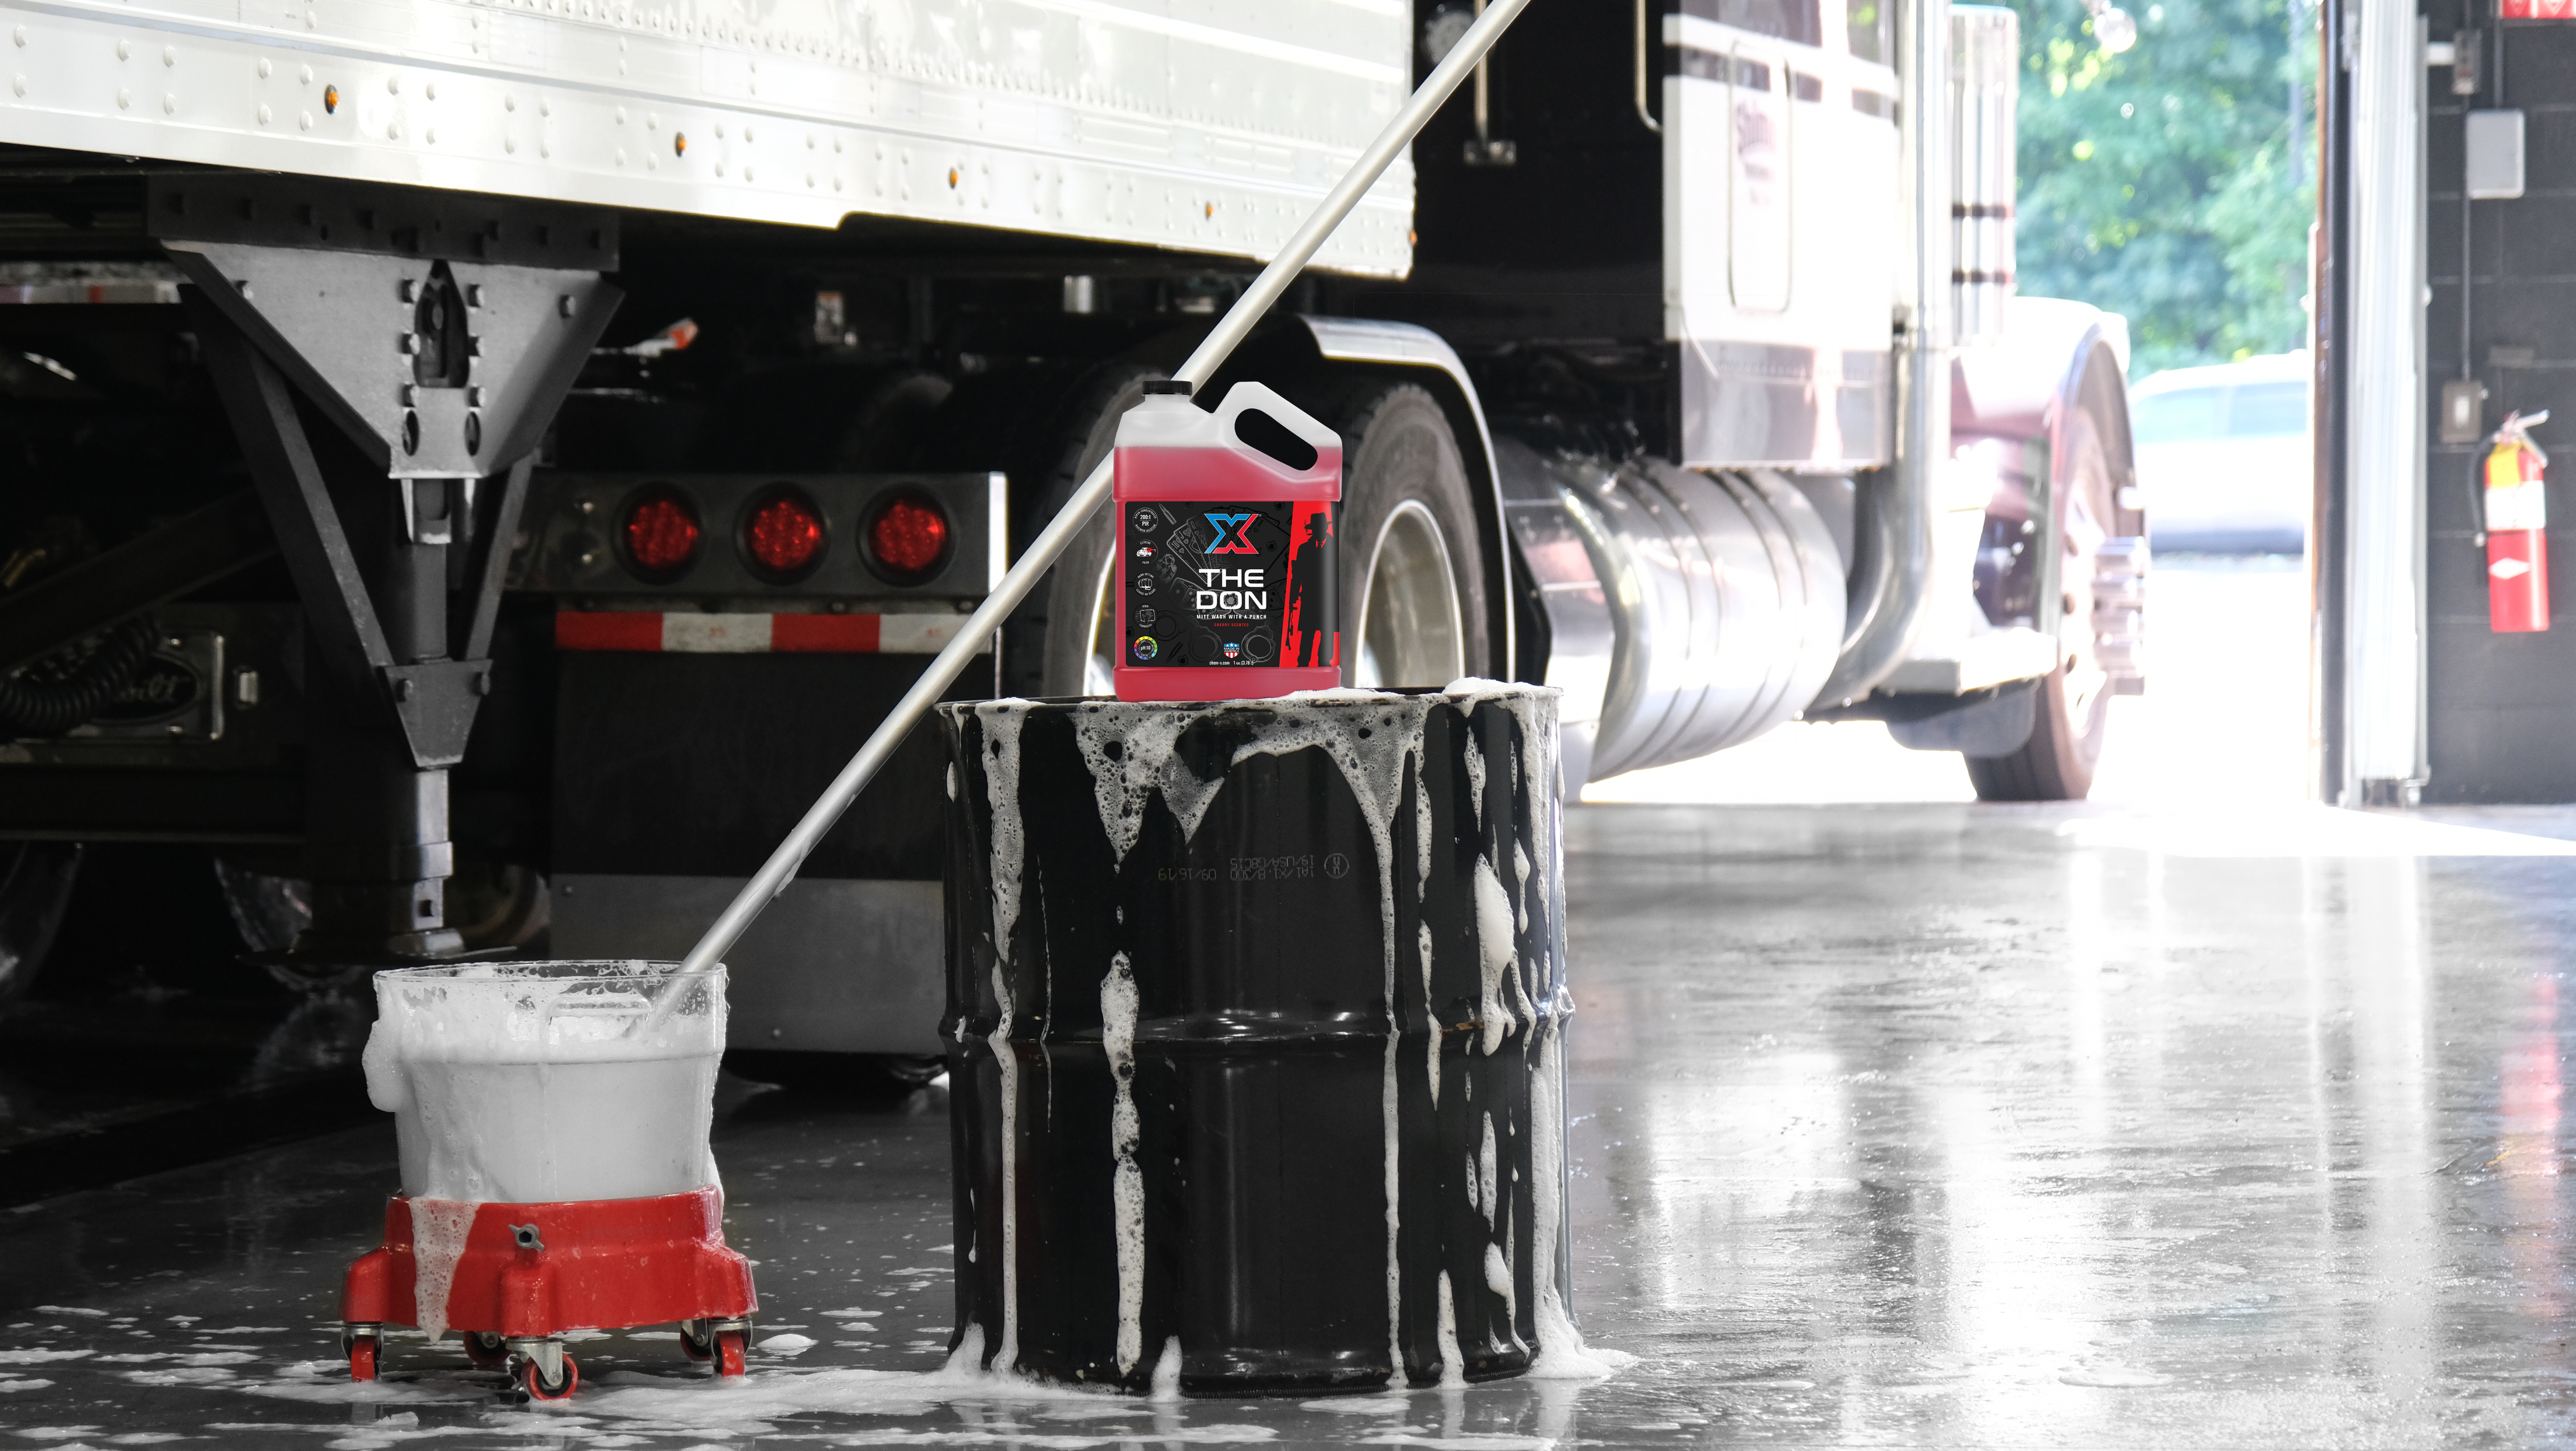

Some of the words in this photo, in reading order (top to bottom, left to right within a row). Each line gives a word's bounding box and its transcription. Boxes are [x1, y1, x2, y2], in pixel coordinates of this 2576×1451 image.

[1135, 524, 1146, 532] MAXIMUM
[1146, 524, 1156, 532] DILUTION
[1198, 569, 1264, 587] THE
[1196, 591, 1266, 609] DON
